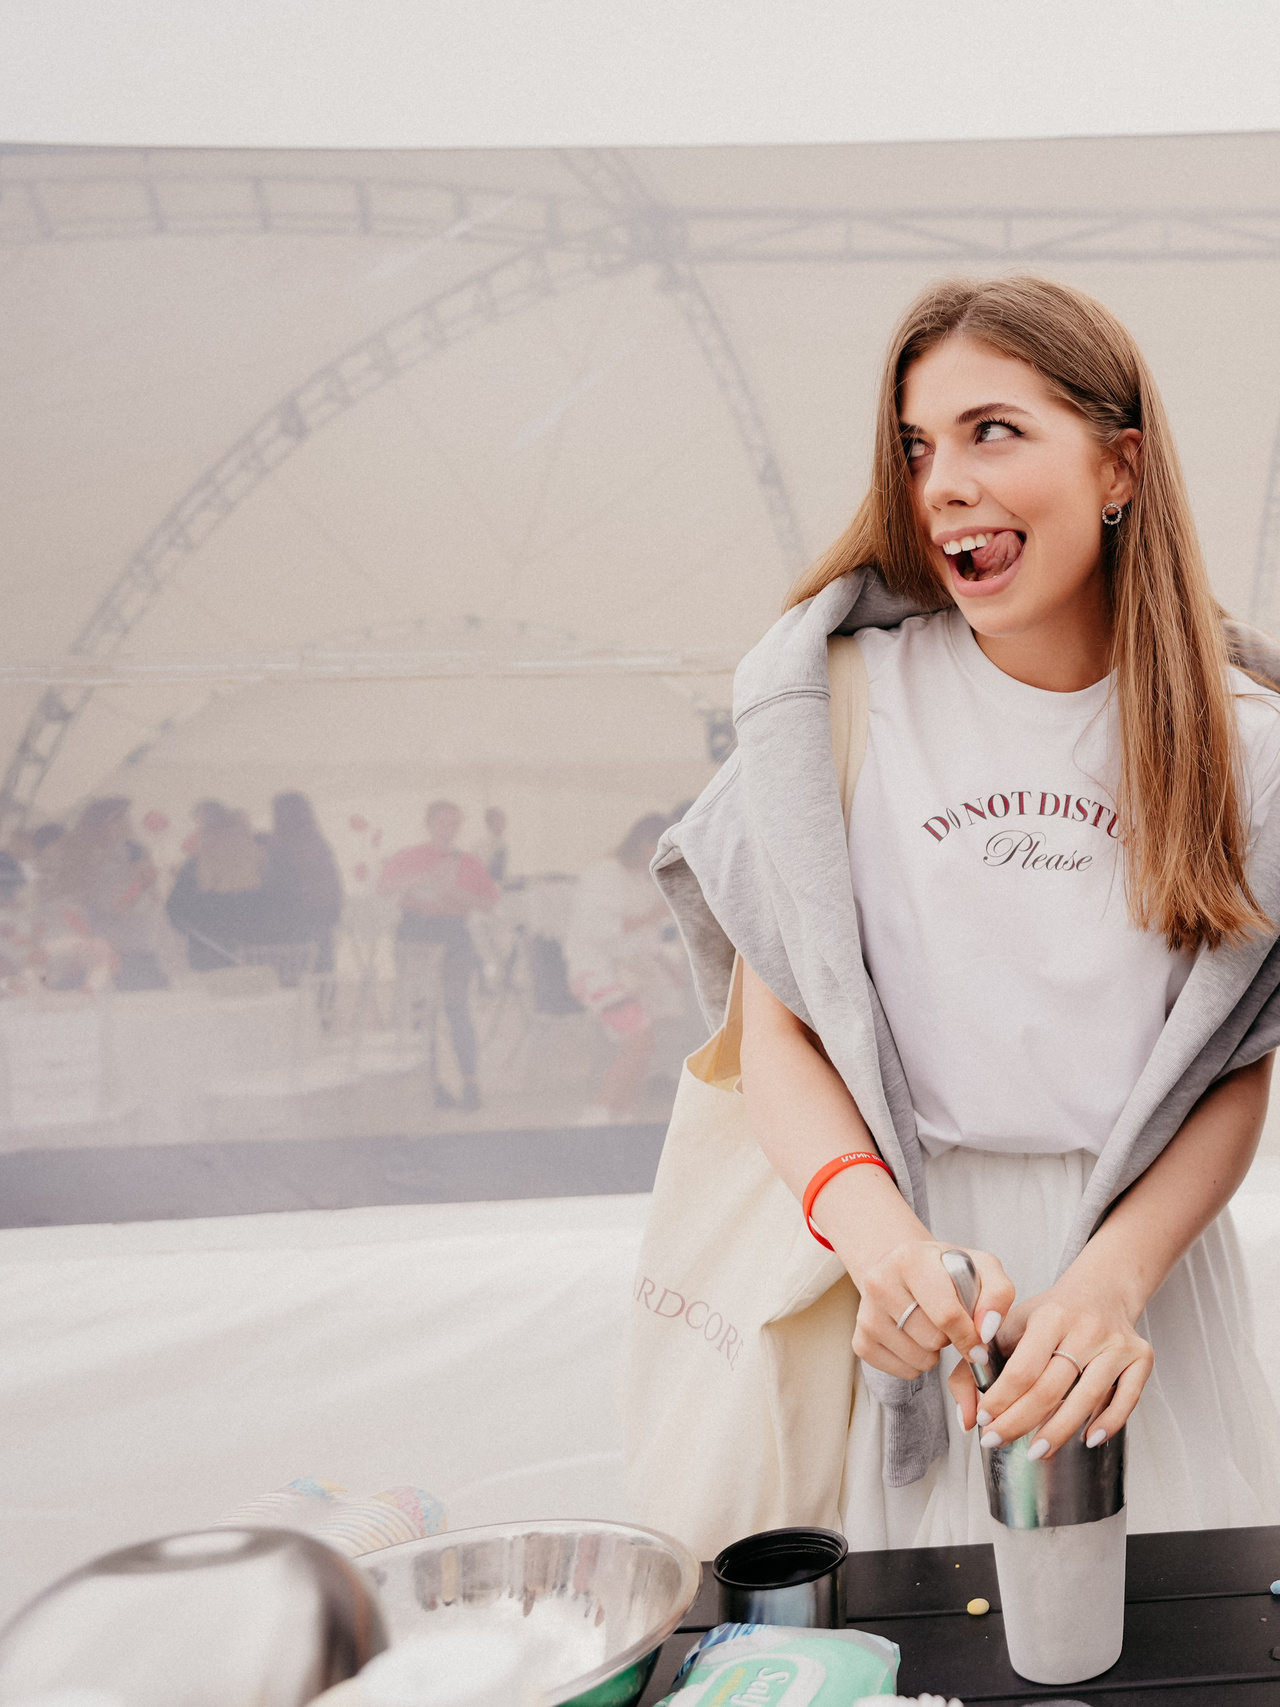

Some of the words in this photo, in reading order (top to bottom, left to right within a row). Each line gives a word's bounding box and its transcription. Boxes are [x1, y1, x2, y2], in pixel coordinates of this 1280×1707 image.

[921, 807, 961, 844] DO
[961, 790, 1031, 827] NOT
[982, 829, 1093, 872] Please
[632, 1276, 744, 1371] RDCOR
